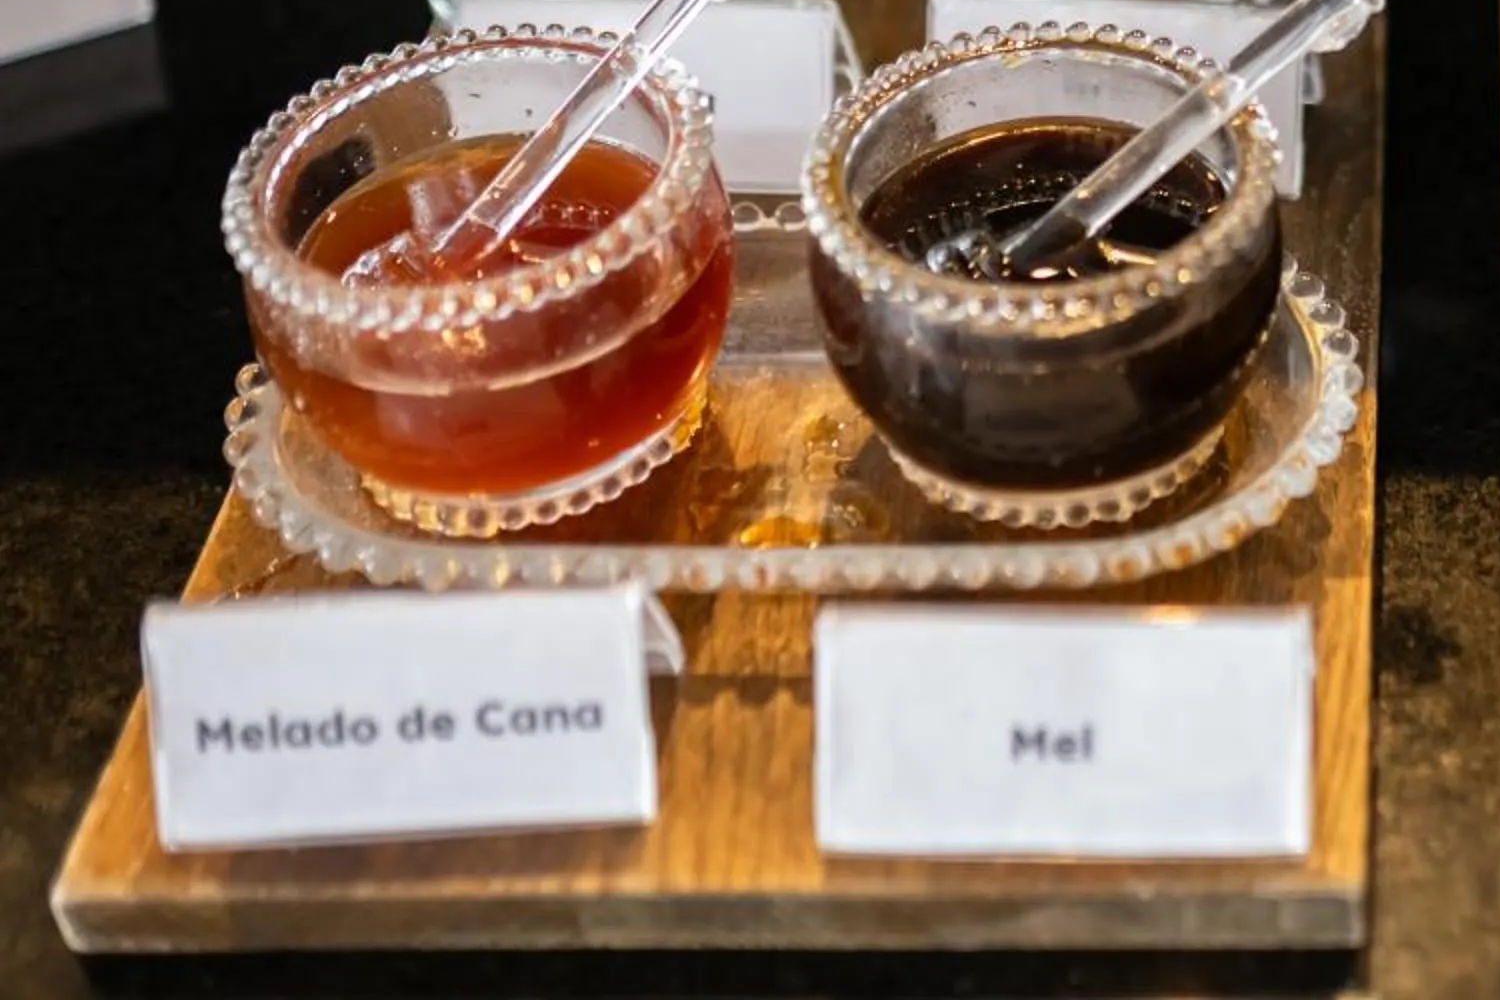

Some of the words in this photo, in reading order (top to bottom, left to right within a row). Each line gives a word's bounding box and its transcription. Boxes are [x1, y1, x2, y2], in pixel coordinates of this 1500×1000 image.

[196, 711, 380, 753] Melado
[398, 705, 456, 741] de
[475, 698, 604, 736] Cana
[1010, 722, 1095, 764] Mel
